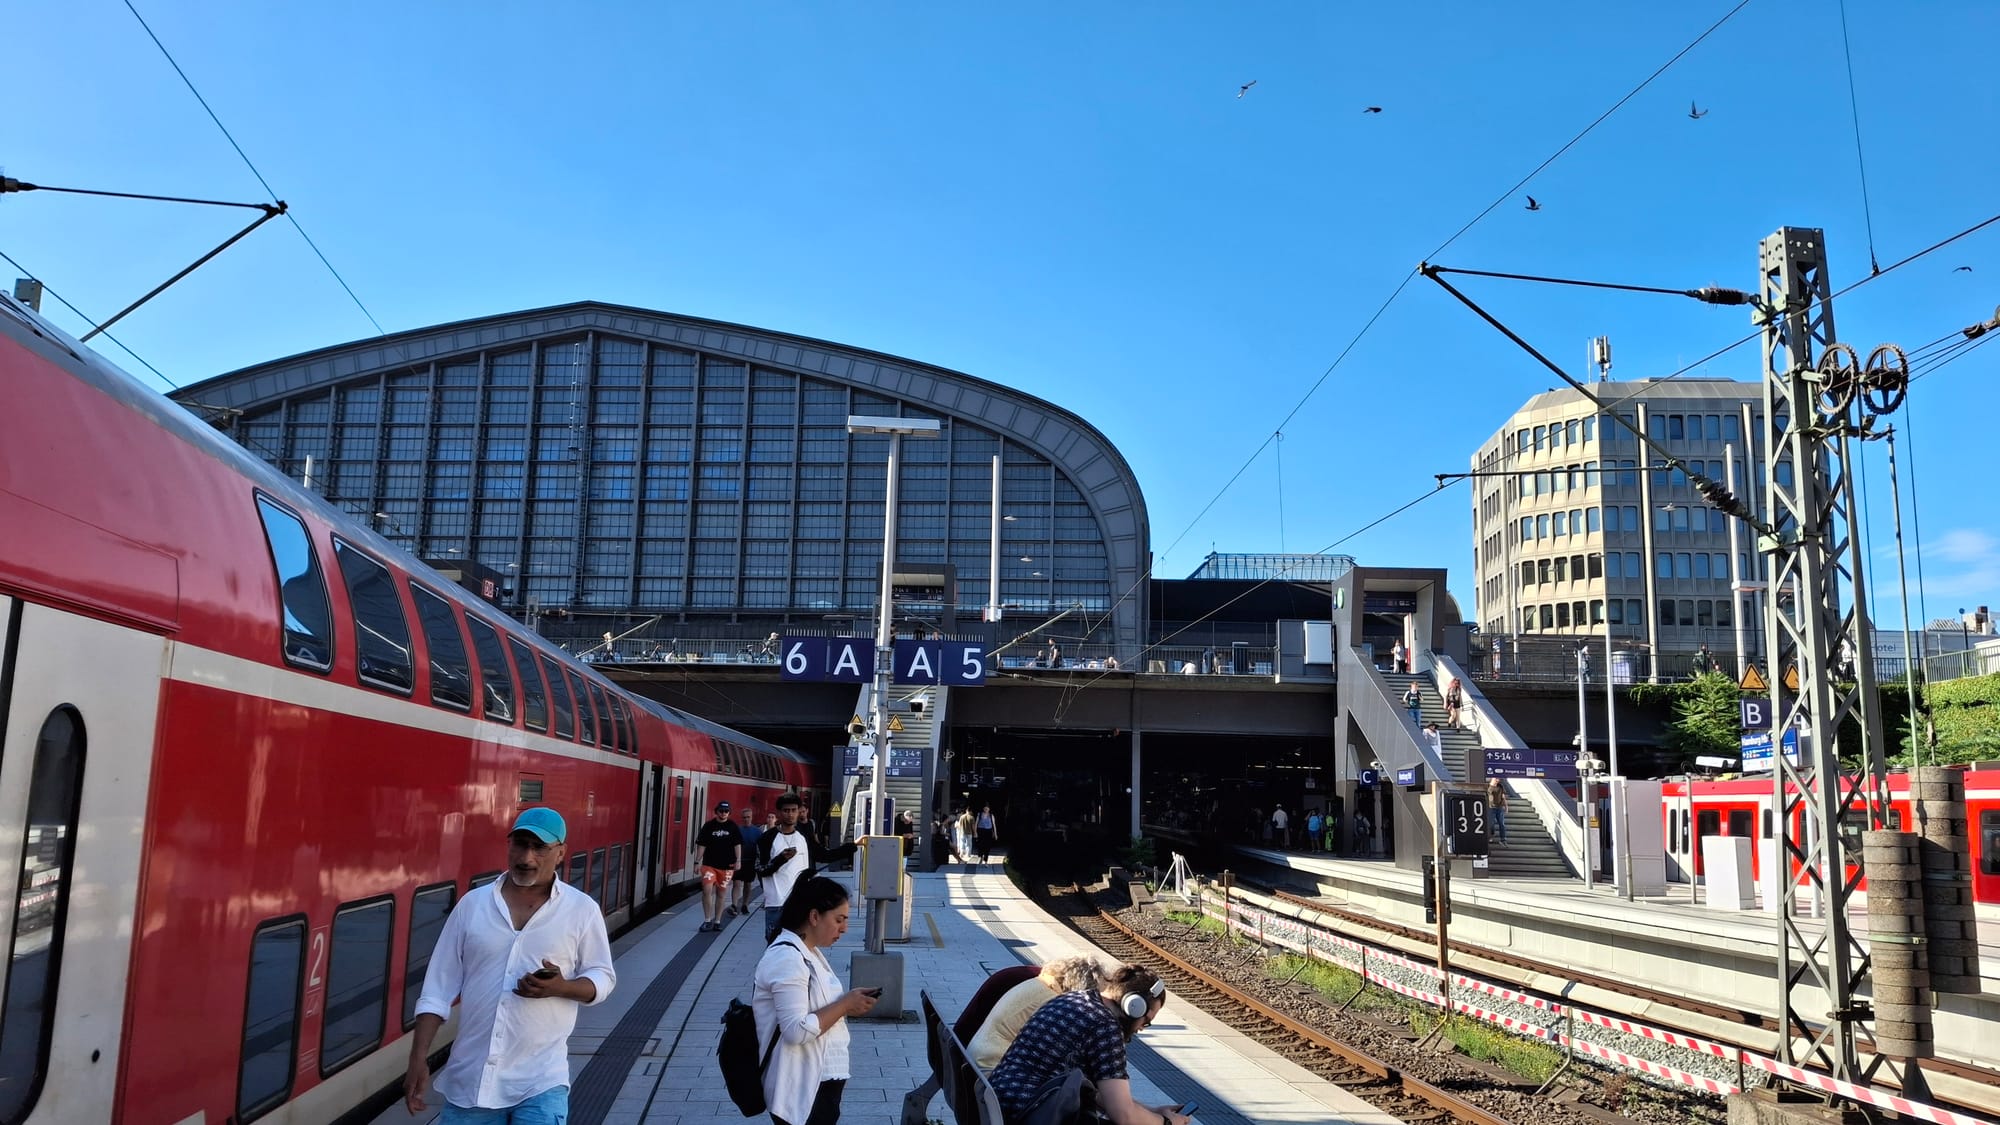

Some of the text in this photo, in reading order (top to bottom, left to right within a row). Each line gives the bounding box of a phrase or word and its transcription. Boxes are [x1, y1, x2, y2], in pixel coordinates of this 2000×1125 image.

[785, 641, 860, 676] 6 A
[1872, 643, 1896, 652] otel
[907, 647, 982, 679] A 5
[1746, 703, 1762, 725] B
[1494, 752, 1511, 761] 5-14
[1362, 770, 1371, 784] C
[309, 932, 324, 986] 2
